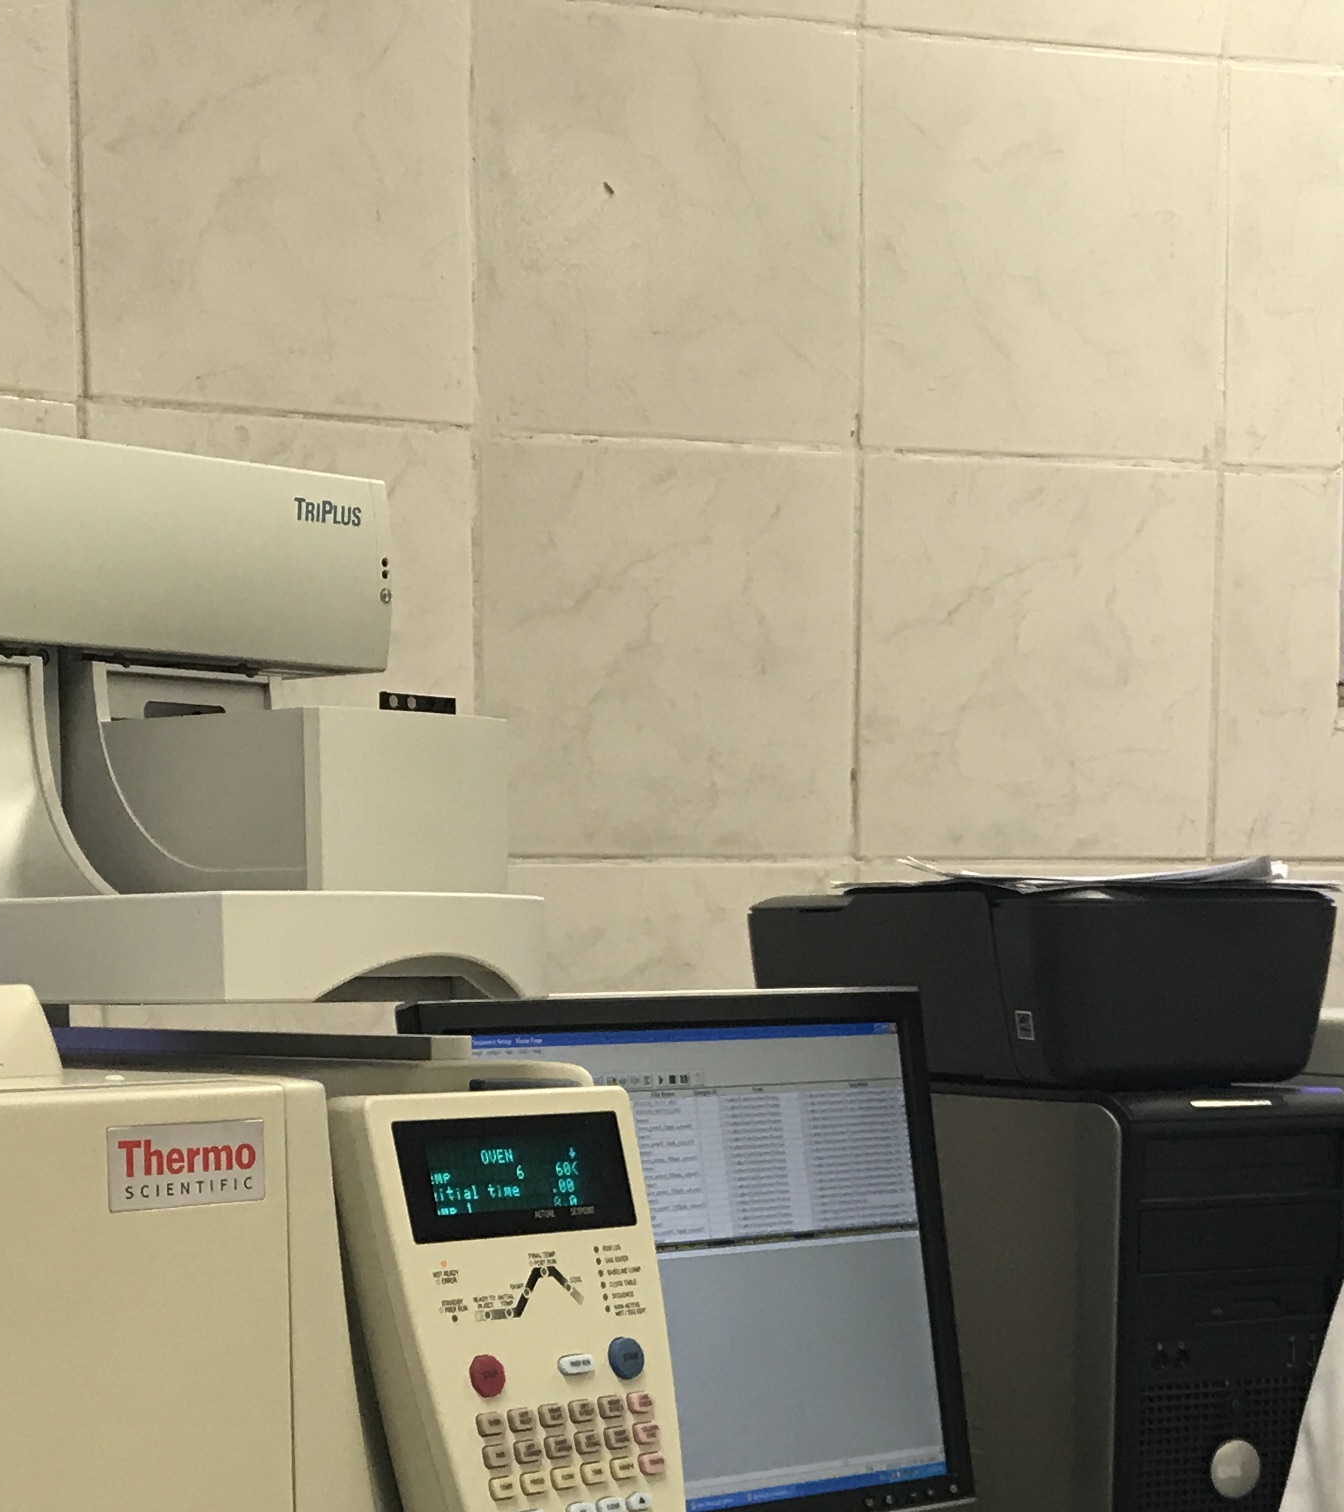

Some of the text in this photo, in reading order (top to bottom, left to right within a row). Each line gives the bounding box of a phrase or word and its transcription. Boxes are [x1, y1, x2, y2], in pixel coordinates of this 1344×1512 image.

[118, 1139, 256, 1178] Thermo
[480, 1148, 514, 1165] OVEN
[125, 1176, 253, 1200] SCIENTIFIC
[487, 1184, 521, 1199] time
